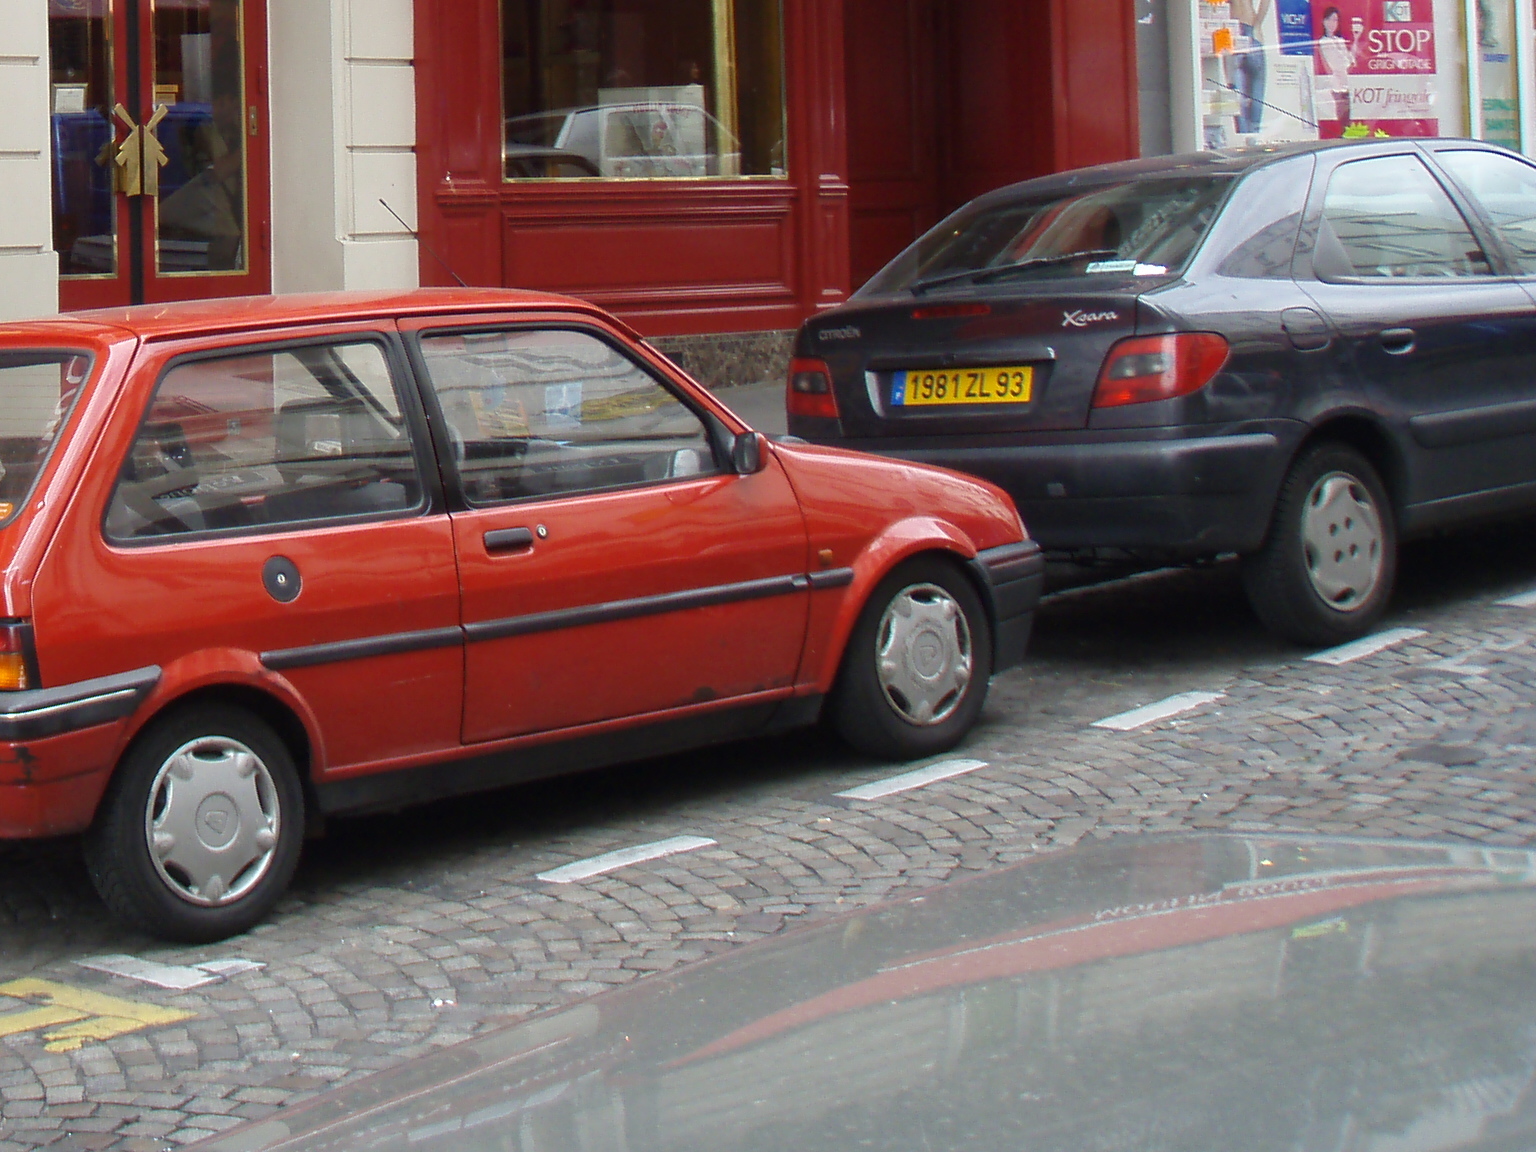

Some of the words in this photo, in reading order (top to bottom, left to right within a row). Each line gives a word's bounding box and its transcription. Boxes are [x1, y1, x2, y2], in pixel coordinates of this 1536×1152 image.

[1367, 29, 1431, 53] STOP
[1352, 87, 1384, 104] KOT
[1061, 308, 1119, 327] Xsara
[911, 373, 961, 400] 1981
[965, 372, 991, 398] ZL
[995, 371, 1024, 398] 93
